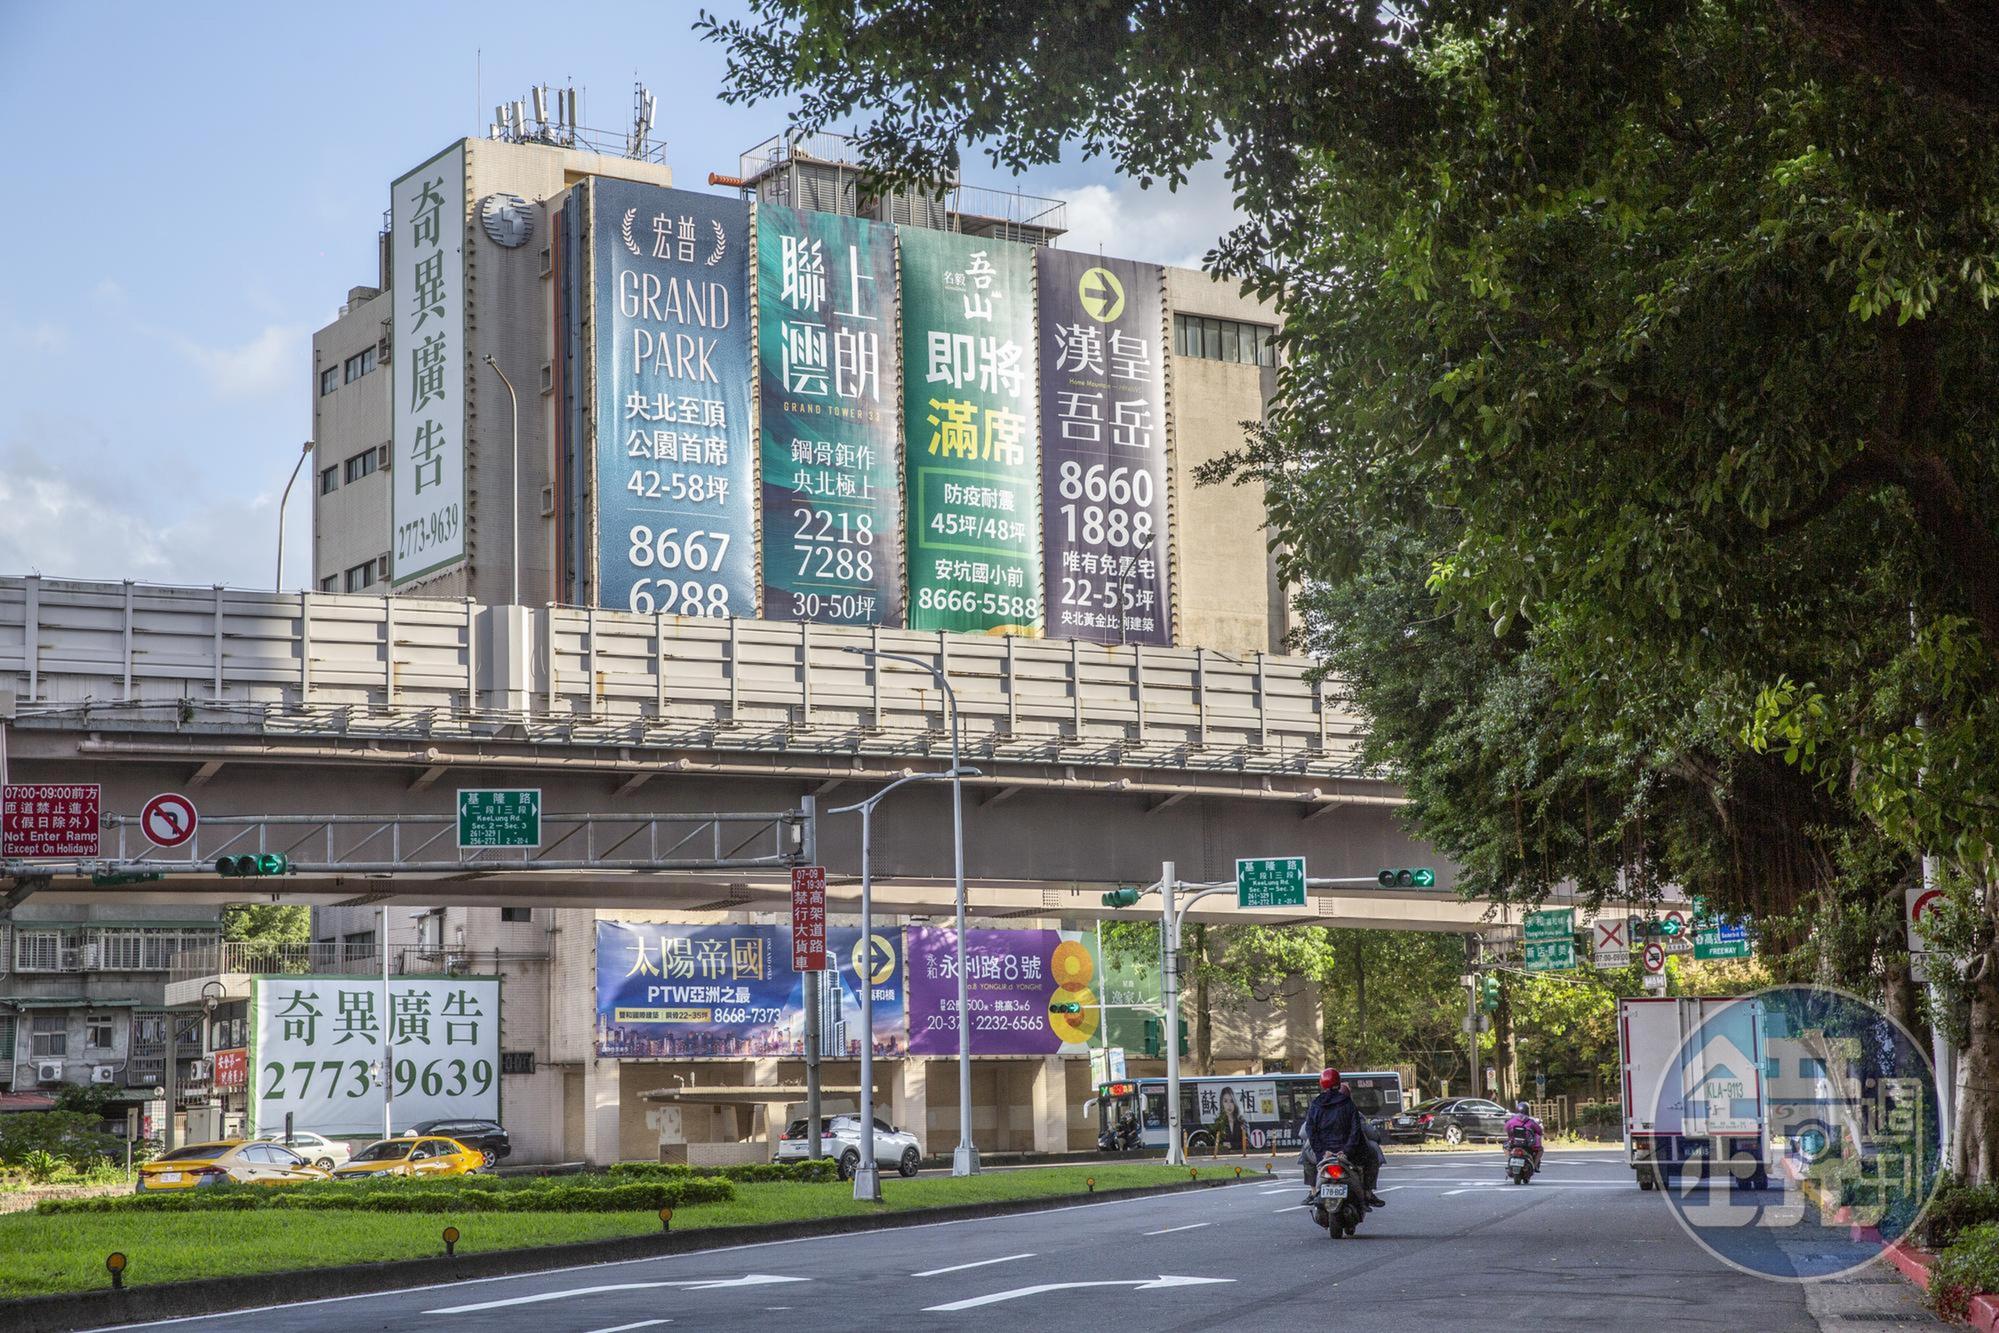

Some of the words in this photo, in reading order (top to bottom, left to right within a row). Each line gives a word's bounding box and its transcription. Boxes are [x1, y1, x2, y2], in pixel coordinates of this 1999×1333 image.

[652, 213, 696, 262] 宏普
[620, 270, 729, 329] GRAND
[409, 176, 446, 496] 奇異廣告
[1054, 322, 1152, 382] 漢皇
[634, 328, 719, 384] PARK
[925, 330, 1025, 398] 即將
[625, 391, 727, 429] 央北至頂
[783, 402, 821, 414] GRAND
[828, 406, 863, 419] TOWER
[1057, 391, 1155, 448] 吾岳
[626, 429, 728, 466] 公園首席
[926, 398, 1026, 466] 滿席
[791, 438, 876, 471] 鋼骨鉅作
[627, 470, 730, 505] 42-58坪
[792, 468, 876, 500] 央北極上
[944, 483, 1015, 511] 防疫耐震
[1059, 460, 1153, 508] 8660
[399, 502, 459, 561] 2773-9639
[793, 508, 873, 546] 2218
[930, 513, 1026, 543] 45坪/48坪
[1060, 503, 1153, 550] 1888
[629, 525, 730, 572] 8667
[794, 545, 873, 582] 7288
[1062, 550, 1155, 579] 唯有免震宅
[935, 559, 1024, 588] 安坑國小前
[629, 578, 730, 619] 6288
[792, 592, 877, 621] 30-50坪
[918, 588, 1039, 619] 8666-5588
[1061, 577, 1155, 611] 22-55坪
[5, 801, 97, 814] 匝道禁止進入
[468, 793, 531, 804] 基隆路
[472, 805, 494, 814] 二段
[504, 805, 527, 814] 三段
[4, 832, 24, 841] Not
[31, 831, 60, 841] Enter
[66, 831, 97, 842] Ramp
[4, 843, 39, 855] (Except
[43, 844, 54, 853] On
[57, 843, 97, 854] Holidays)
[797, 869, 818, 879] 07-09
[1245, 860, 1297, 872] 基隆路
[1248, 872, 1267, 880] 二段
[1275, 871, 1294, 879] 三段
[794, 891, 809, 969] 禁行大貨車
[809, 890, 823, 953] 高架道路
[625, 936, 763, 980] 太陽帝國
[926, 954, 937, 979] 永和
[939, 954, 1041, 980] 永利路8號
[1709, 947, 1736, 955] FREEWAY
[648, 986, 750, 1003] PTW亞洲之最
[275, 989, 484, 1047] 奇異廣告
[714, 1008, 781, 1023] 8668-7373
[976, 1016, 1043, 1030] 2232-6565
[1707, 1082, 1743, 1098] KLA-9113
[1252, 1131, 1263, 1146] 11
